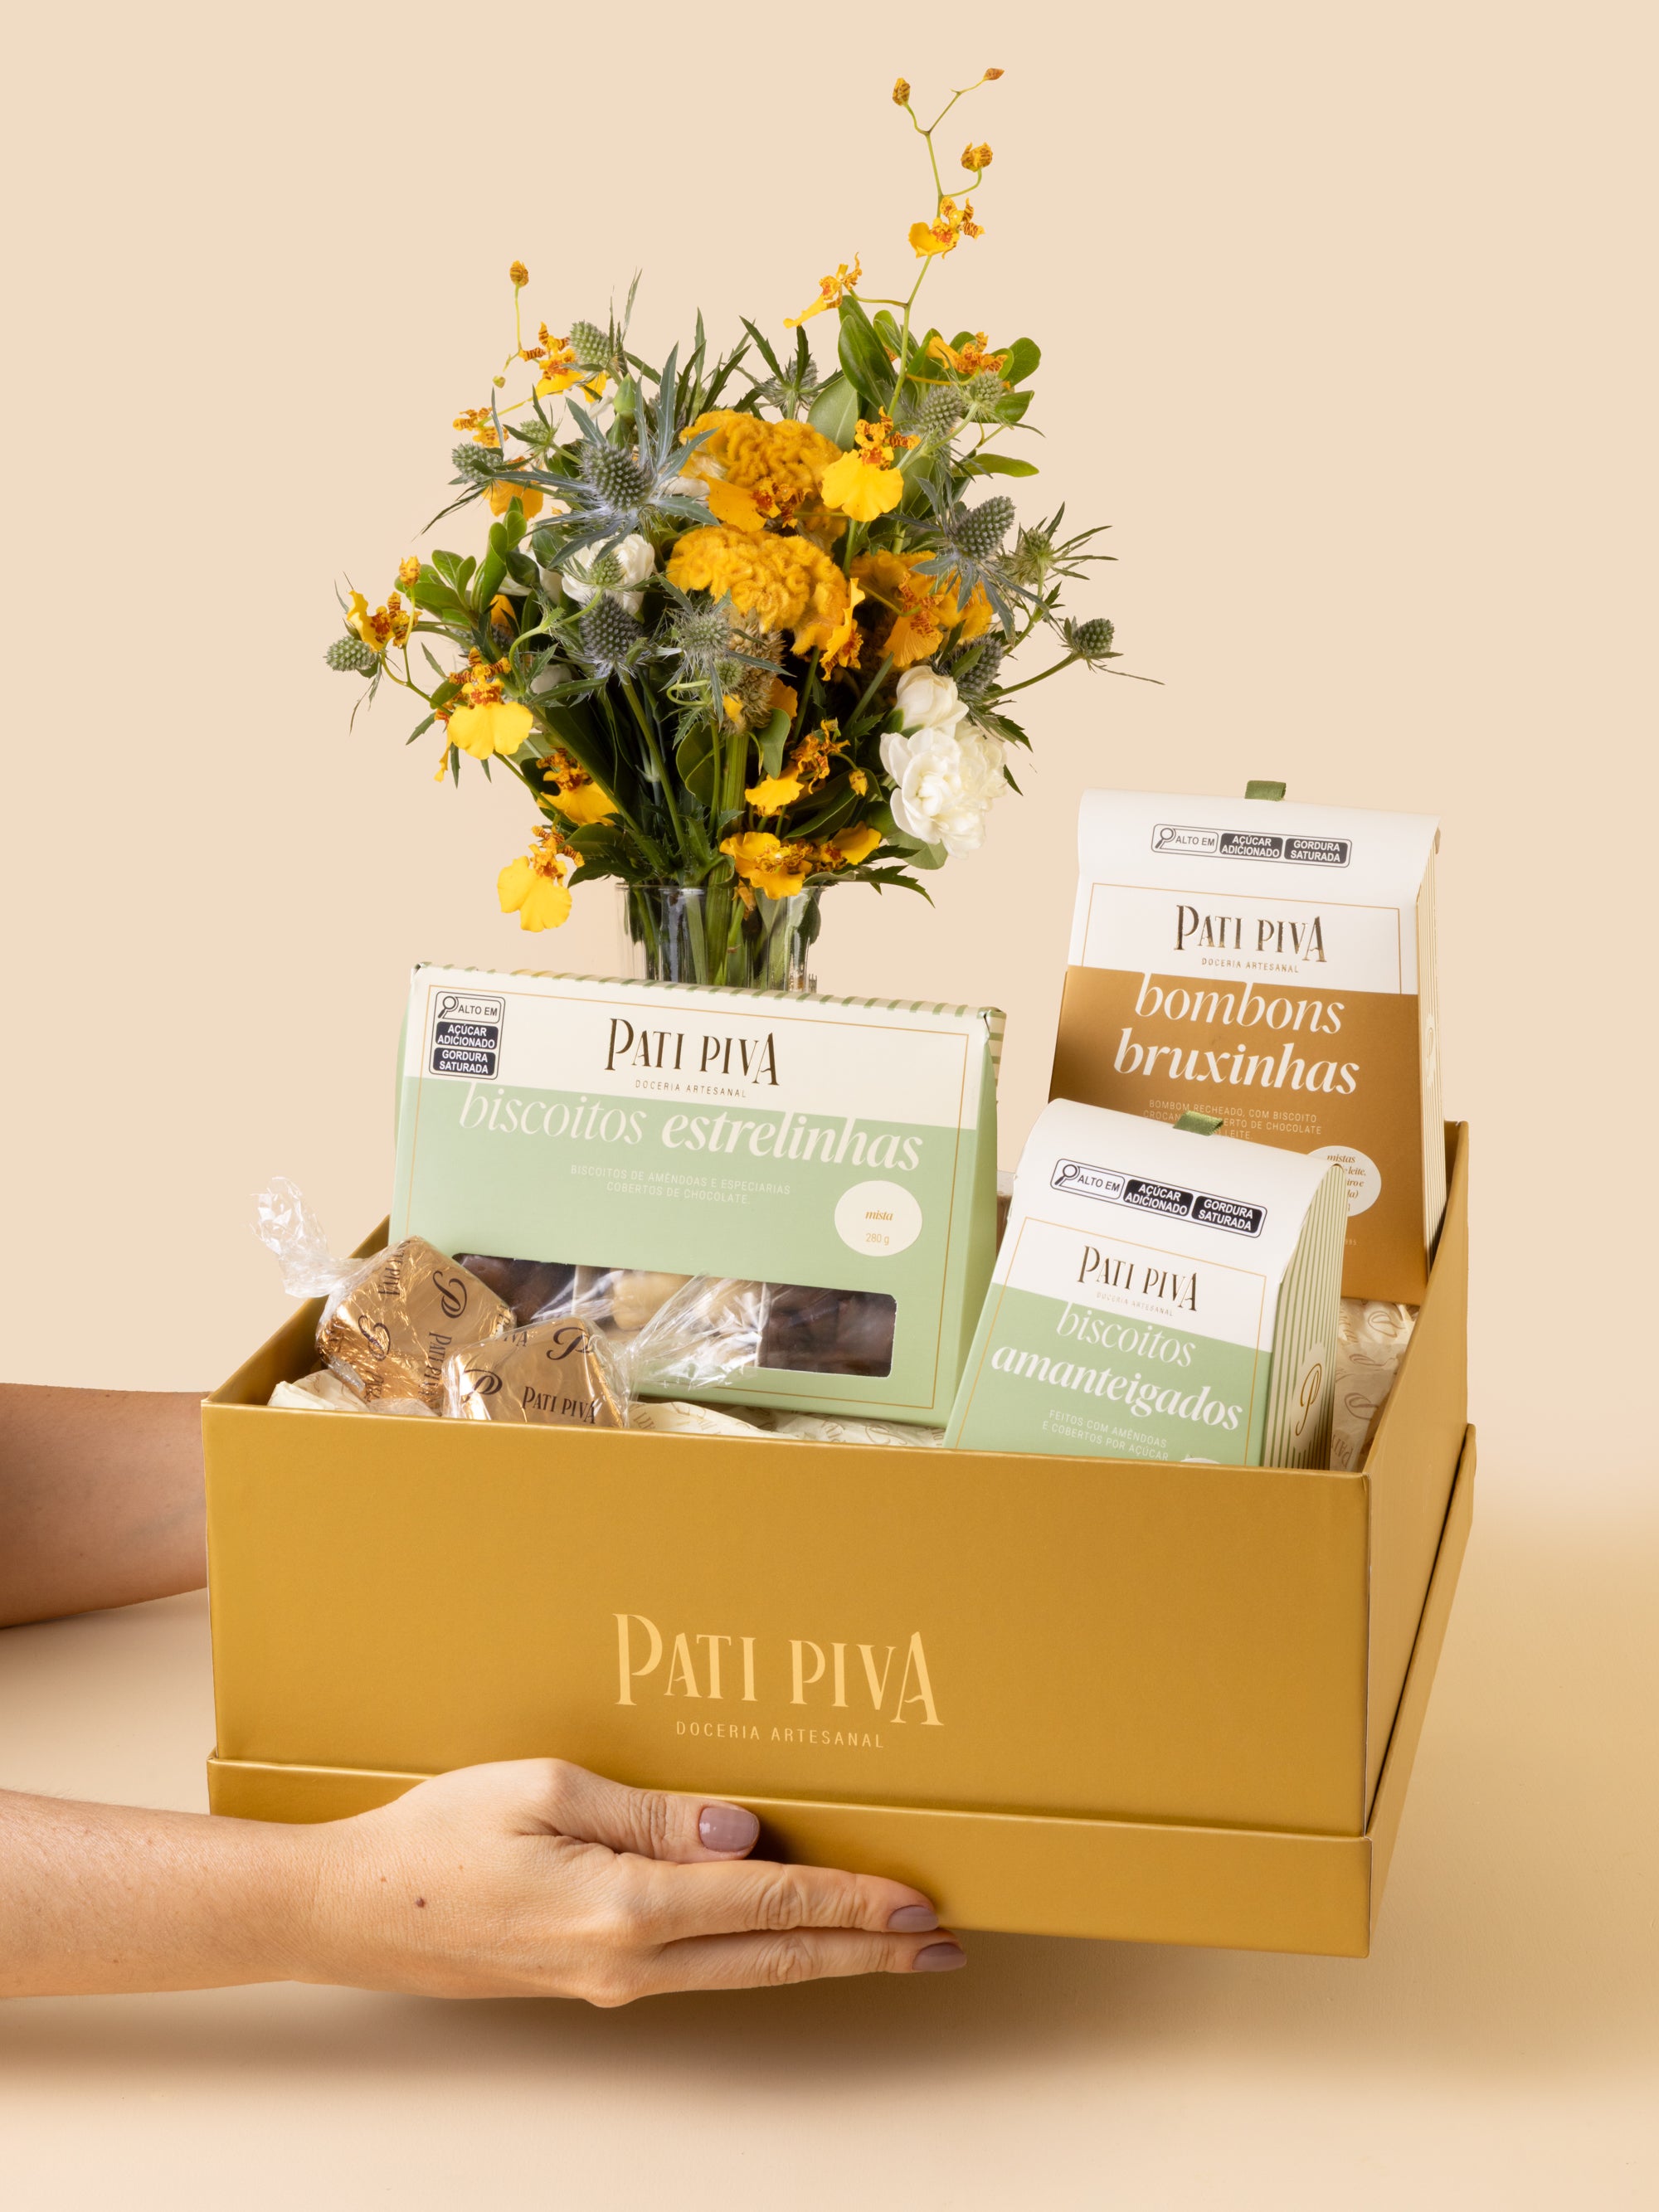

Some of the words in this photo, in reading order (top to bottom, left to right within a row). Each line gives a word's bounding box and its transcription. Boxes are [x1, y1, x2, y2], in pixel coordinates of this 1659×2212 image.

[1175, 835, 1199, 845] ALTO
[1202, 838, 1214, 846] EM
[1232, 834, 1272, 848] AÇÚCAR
[1294, 840, 1340, 852] GORDURA
[1221, 844, 1280, 858] ADICIONADO
[1291, 850, 1340, 863] SATURADA
[1174, 905, 1244, 950] PATI
[1256, 916, 1327, 962] PIVA
[1202, 957, 1242, 968] DOCERIA
[1245, 962, 1299, 973] ARTESANAL
[458, 1004, 482, 1016] ALTO
[484, 1007, 498, 1017] EM
[1135, 972, 1345, 1034] bombons
[447, 1023, 487, 1038] AÇÚCAR
[437, 1034, 496, 1049] ADICIONADO
[442, 1049, 489, 1062] GORDURA
[605, 1018, 685, 1072] PATI
[699, 1032, 780, 1086] PIVA
[1113, 1027, 1360, 1095] bruxinhas
[439, 1060, 489, 1074] SATURADA
[635, 1080, 680, 1091] DOCERIA
[686, 1085, 747, 1098] ARTESANAL
[1143, 1110, 1181, 1121] CROCAN
[1149, 1100, 1190, 1111] BOMBOM
[1194, 1104, 1245, 1117] RECHEADO,
[1249, 1109, 1270, 1118] COM
[1273, 1111, 1317, 1123] BISCOITO
[459, 1082, 647, 1145] biscoitos
[661, 1111, 923, 1171] estrelinhas
[1251, 1121, 1262, 1129] DE
[1266, 1122, 1321, 1135] CHOCOLATE
[1327, 1154, 1356, 1164] mistas
[571, 1164, 627, 1179] BISCOITOS
[630, 1170, 645, 1181] DE
[648, 1171, 707, 1187] AMÊNDOAS
[711, 1178, 718, 1187] E
[721, 1179, 791, 1195] ESPECIARIAS
[1078, 1174, 1103, 1189] ALTO
[1106, 1181, 1120, 1193] EM
[606, 1181, 664, 1196] COBERTOS
[666, 1188, 680, 1198] DE
[1138, 1184, 1182, 1203] AÇÚCAR
[1125, 1193, 1188, 1216] ADICIONADO
[1204, 1199, 1253, 1219] GORDURA
[864, 1210, 893, 1221] mista
[1198, 1209, 1252, 1231] SATURADA
[865, 1232, 882, 1243] 280
[883, 1235, 890, 1246] g
[1077, 1245, 1135, 1290] PATI
[1142, 1272, 1197, 1311] PIVA
[1131, 1300, 1174, 1317] ARTESANAL
[1055, 1302, 1197, 1368] biscoitos
[990, 1345, 1244, 1431] amanteigados
[523, 1386, 557, 1412] PATI
[1048, 1409, 1084, 1427] FEITOS
[1087, 1420, 1108, 1432] COM
[1112, 1427, 1167, 1448] AMÊNDOAS
[1042, 1421, 1049, 1430] E
[1051, 1423, 1102, 1445] COBERTOS
[1106, 1437, 1126, 1451] POR
[1128, 1445, 1169, 1461] AÇÚCAR
[612, 1613, 758, 1705] PATI
[788, 1631, 944, 1726] PIVA
[676, 1720, 760, 1741] DOCERIA
[771, 1727, 883, 1748] ARTESANAL
